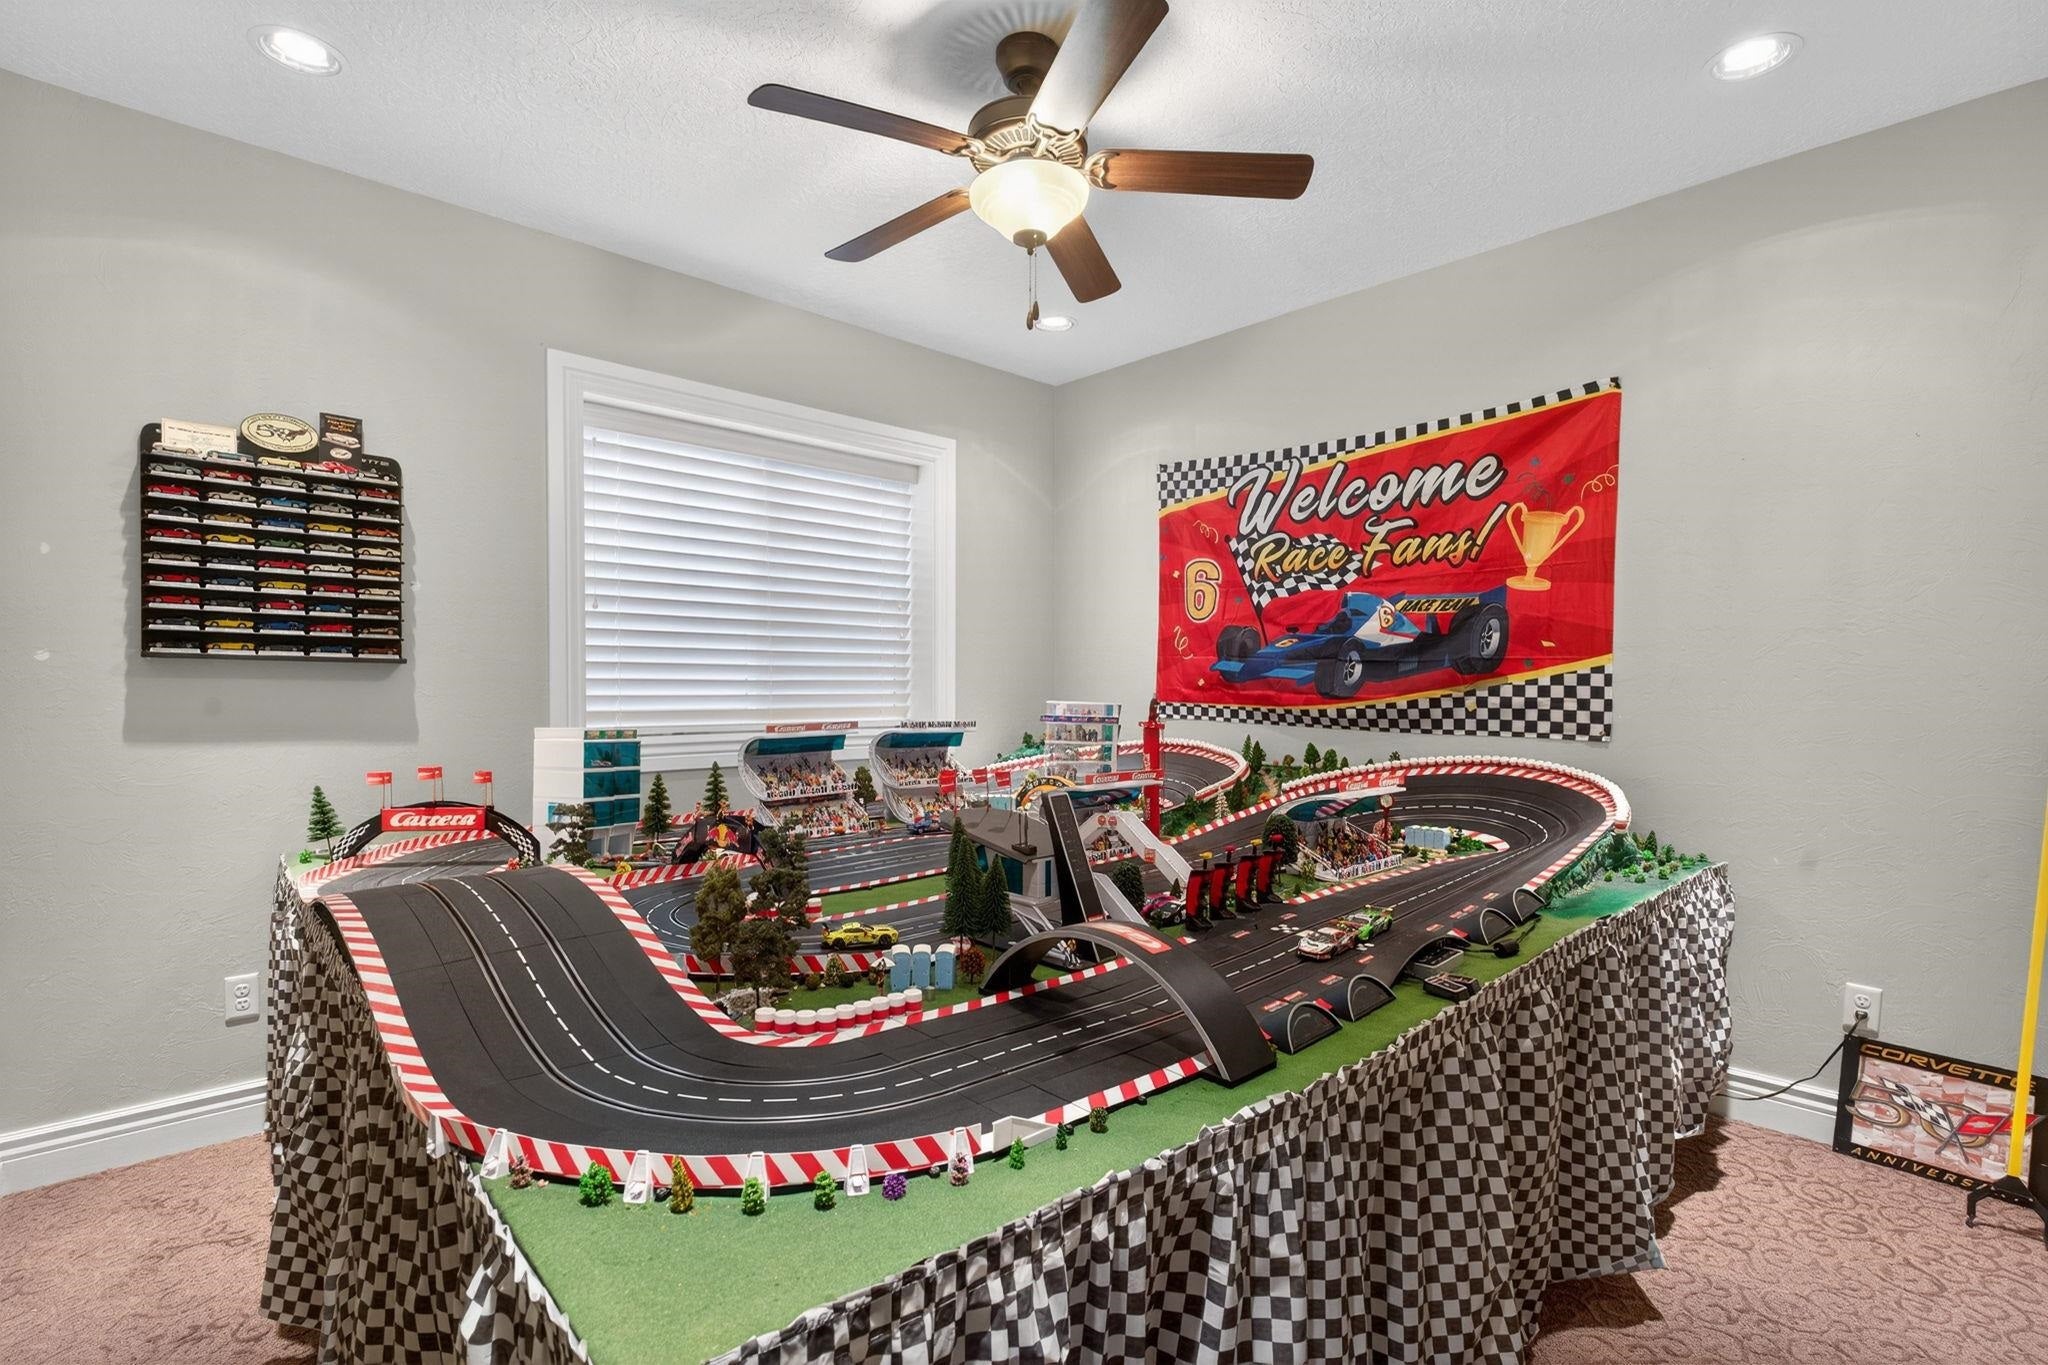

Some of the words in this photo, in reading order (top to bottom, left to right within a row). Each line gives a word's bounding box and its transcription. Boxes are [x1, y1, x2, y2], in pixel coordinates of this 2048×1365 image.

[1228, 455, 1507, 535] Welcome
[1250, 532, 1351, 582] Race
[1362, 503, 1507, 577] Fans!
[1184, 558, 1222, 623] 6
[1399, 599, 1434, 612] RACE
[1379, 606, 1396, 628] 6
[390, 812, 476, 827] Carrera
